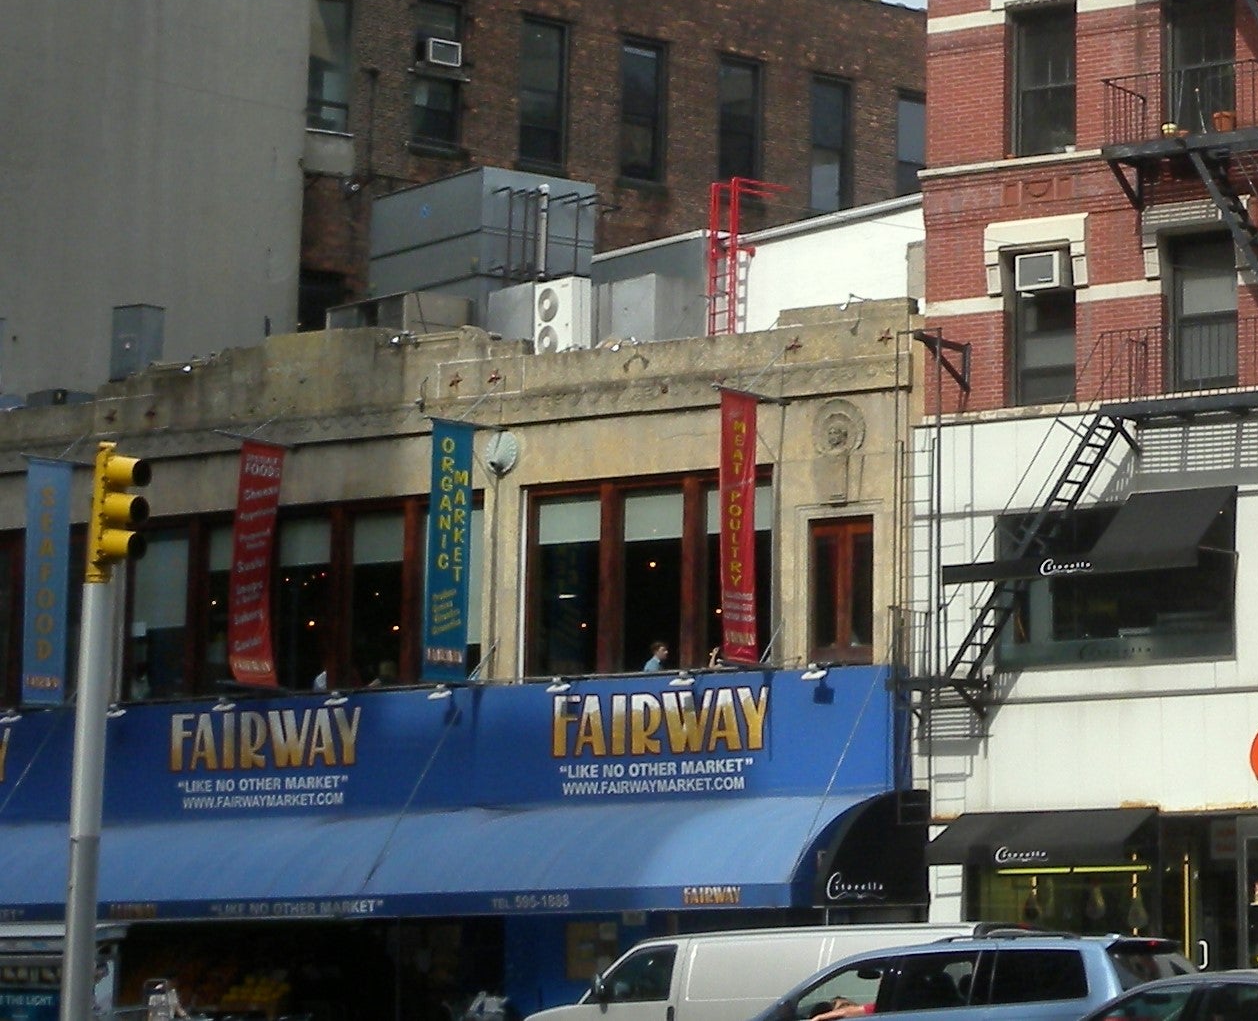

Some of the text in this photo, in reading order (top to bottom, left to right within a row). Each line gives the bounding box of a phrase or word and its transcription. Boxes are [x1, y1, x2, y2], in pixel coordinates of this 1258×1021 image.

[732, 420, 746, 475] MEAT
[437, 437, 455, 570] ORGANIC
[452, 470, 469, 582] MARKET
[728, 491, 744, 587] POULTRY
[34, 486, 56, 661] SEAFOOD
[170, 706, 362, 772] FAIRWAY
[552, 684, 770, 758] FAIRWAY
[216, 778, 235, 792] NO
[239, 776, 281, 791] OTHER
[562, 776, 745, 796] WWW.FAIRWAYMARKET.COM
[602, 763, 624, 778] NO
[628, 762, 677, 778] OTHER
[183, 792, 344, 809] WWW.FAIRWAYMARKET.COM
[249, 903, 268, 915] NO
[272, 902, 315, 915] OTHER
[683, 886, 741, 906] FAIRWAY
[8, 995, 24, 1005] THE
